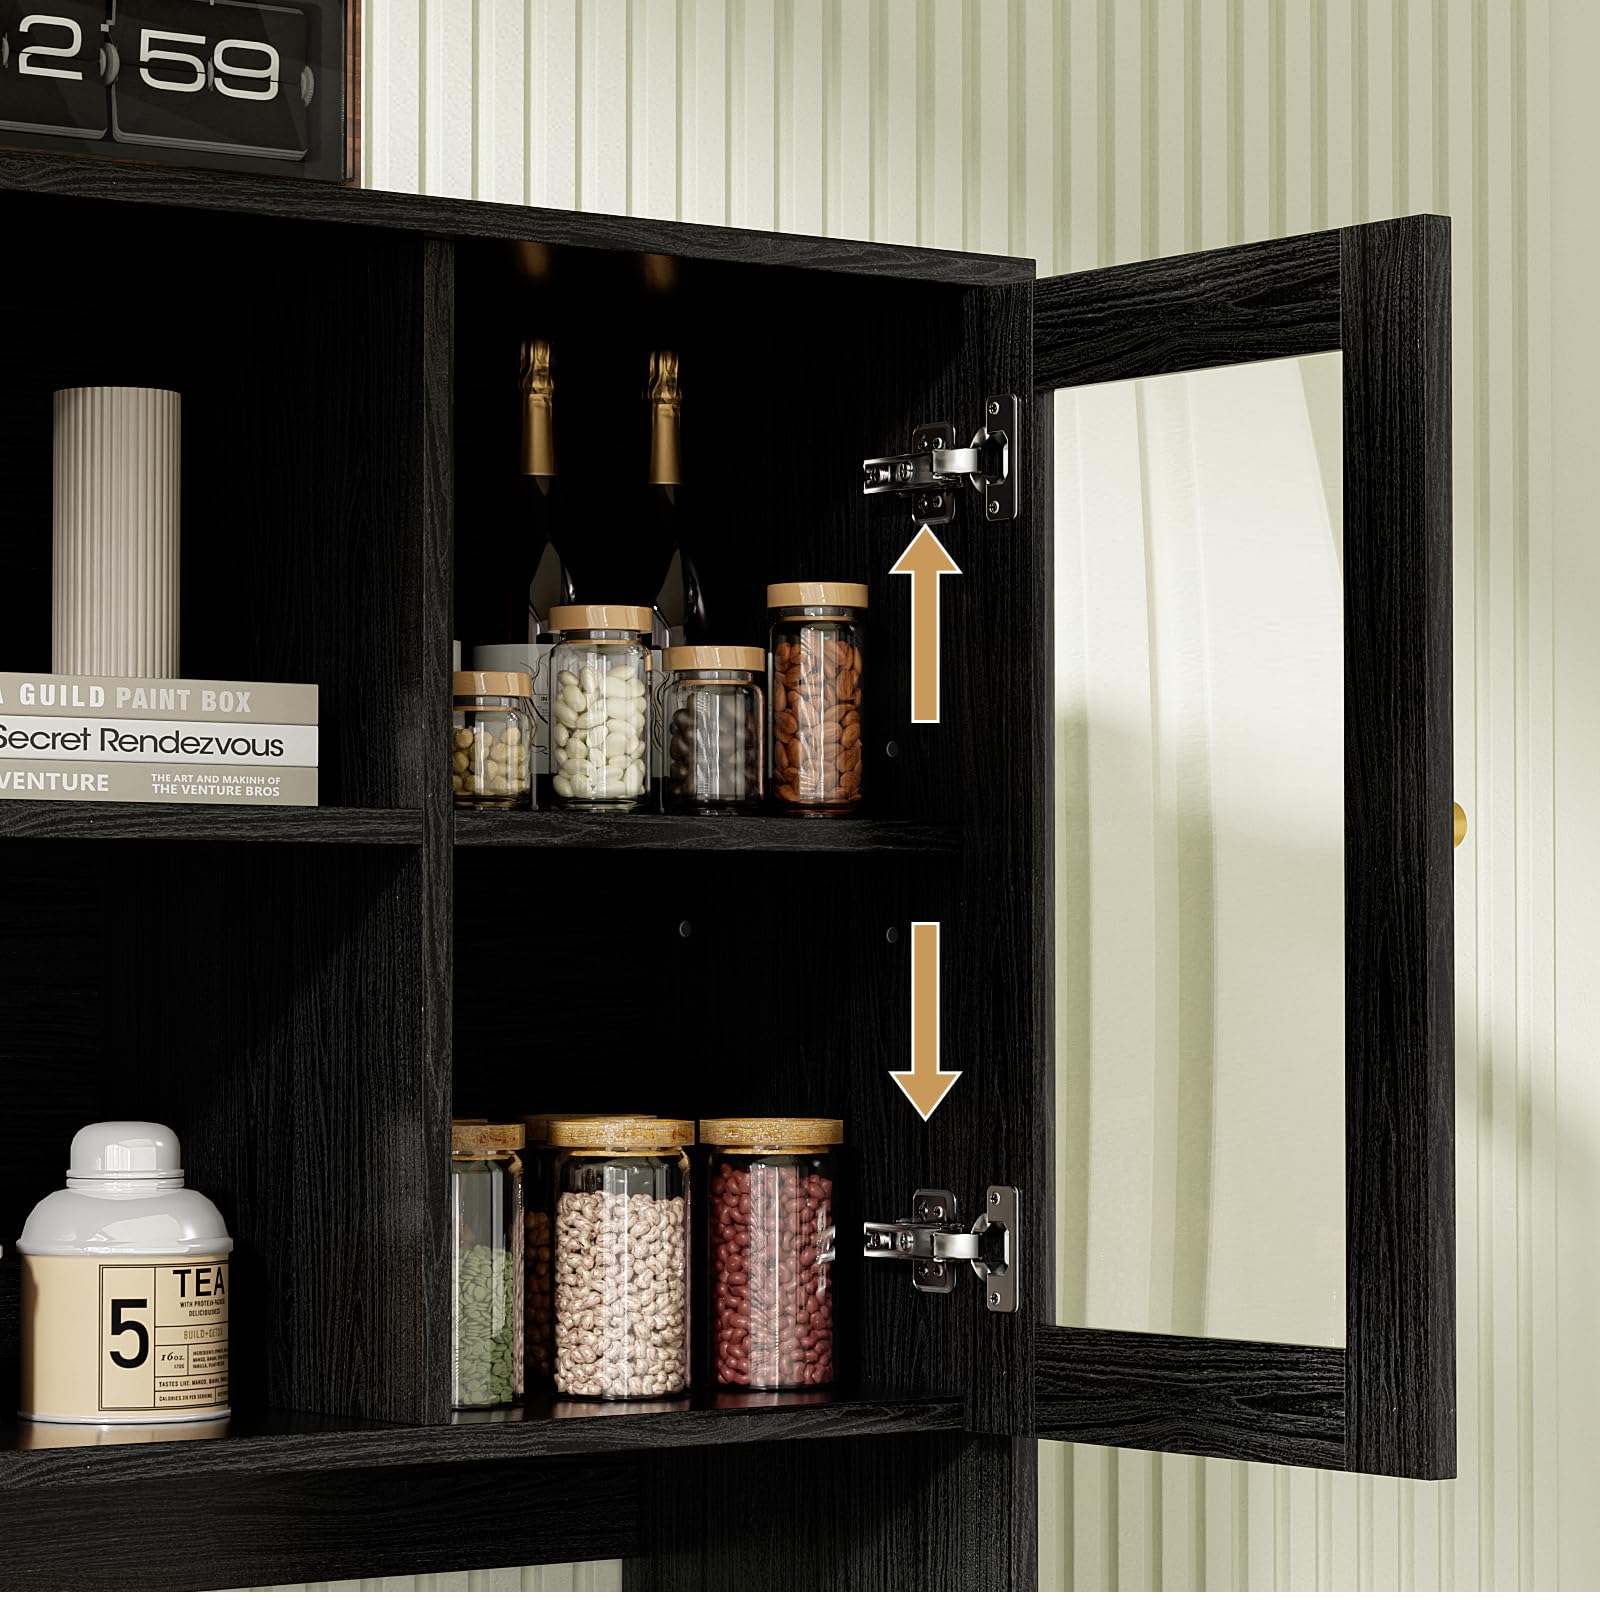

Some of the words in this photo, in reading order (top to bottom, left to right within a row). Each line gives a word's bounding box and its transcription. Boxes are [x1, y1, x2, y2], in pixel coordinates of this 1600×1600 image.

[18, 14, 83, 81] 2
[139, 28, 280, 101] 59
[20, 682, 106, 708] GUILD
[116, 686, 192, 711] PAINT
[201, 690, 252, 713] BOX
[100, 727, 285, 757] Rendezvous
[151, 773, 171, 782] THE
[174, 774, 194, 783] ART
[197, 775, 220, 783] AND
[222, 775, 265, 784] MAKINH
[267, 777, 281, 785] OF
[152, 784, 178, 794] THE
[181, 784, 242, 796] VENTURE
[245, 786, 280, 796] BROS
[173, 1266, 225, 1297] TEA
[110, 1298, 150, 1369] 5
